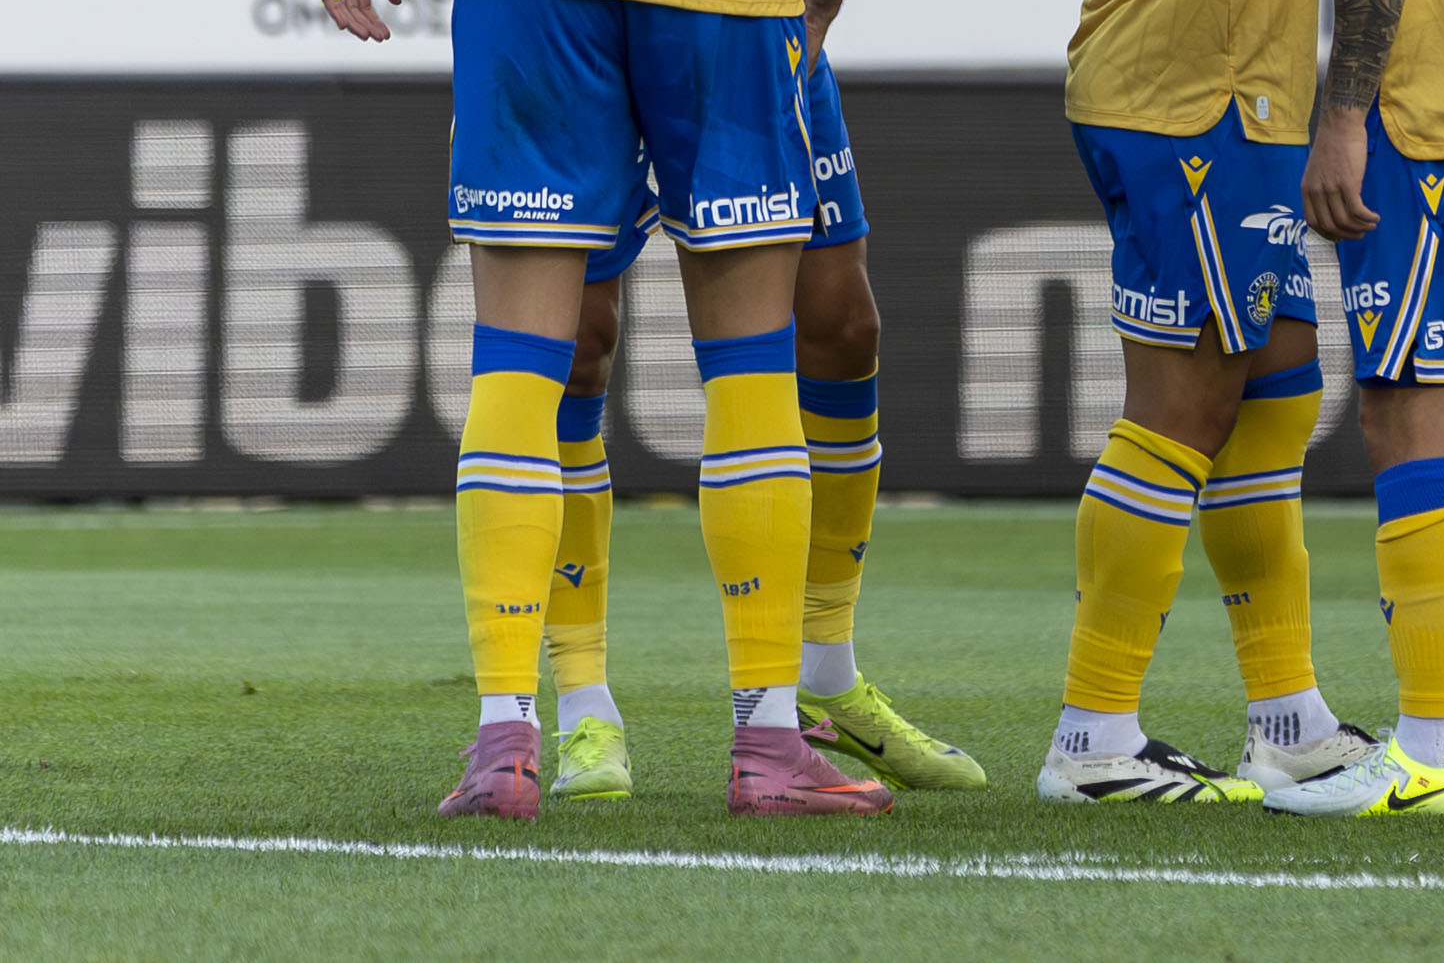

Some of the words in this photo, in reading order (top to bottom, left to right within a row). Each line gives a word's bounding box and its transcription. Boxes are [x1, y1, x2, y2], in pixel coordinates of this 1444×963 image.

[689, 181, 799, 228] romist
[513, 210, 560, 221] DAIKIN
[722, 577, 760, 597] 1931
